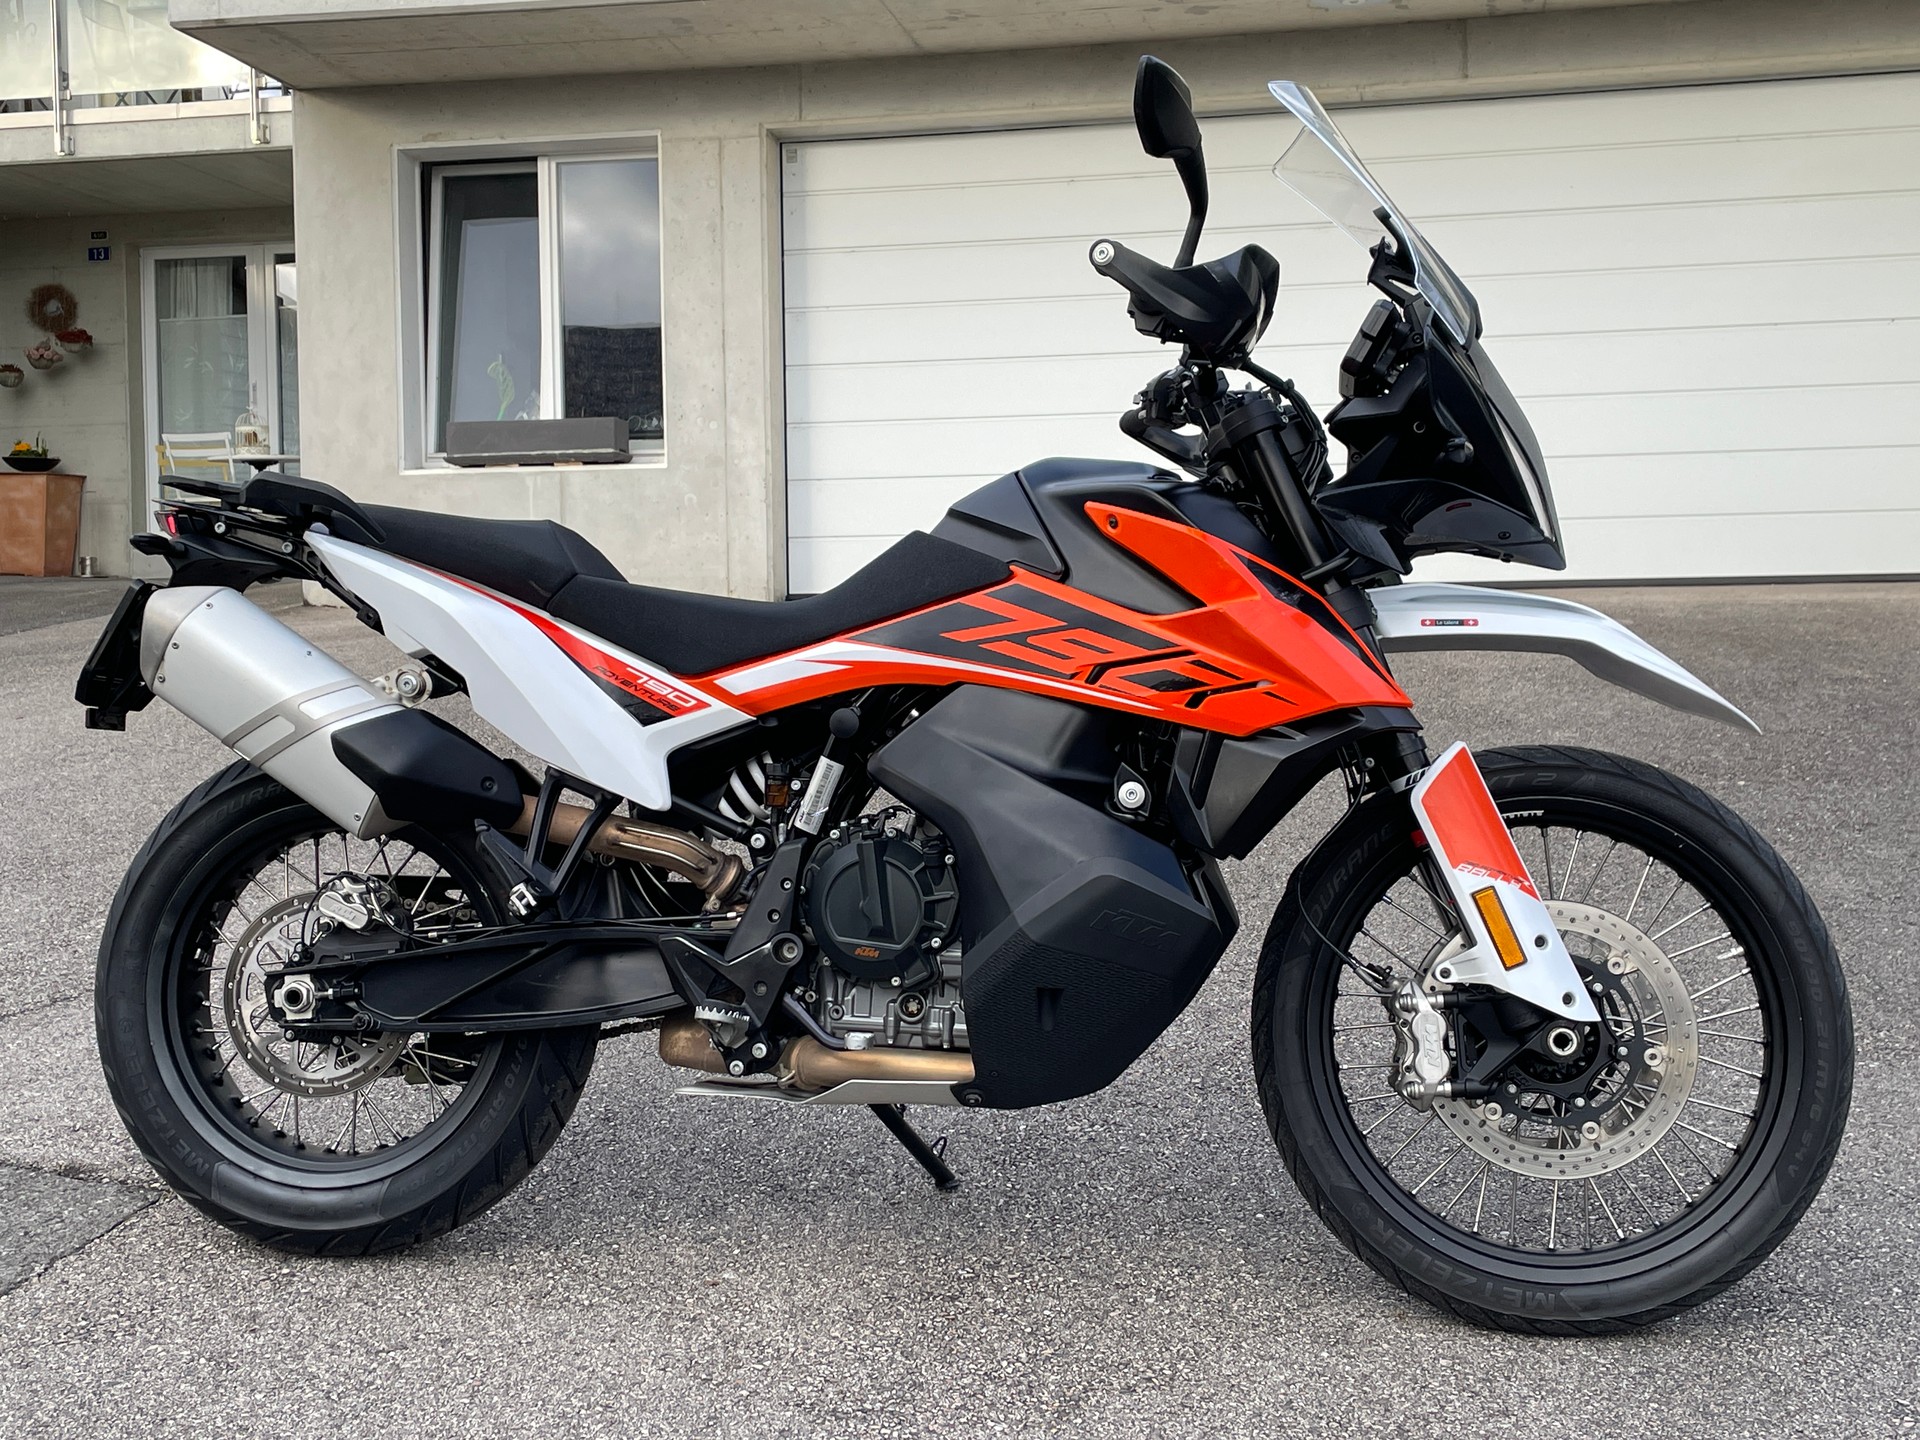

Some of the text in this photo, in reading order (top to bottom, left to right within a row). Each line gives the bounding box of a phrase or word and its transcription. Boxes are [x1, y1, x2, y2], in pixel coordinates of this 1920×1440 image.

[93, 248, 105, 260] 13
[593, 665, 681, 712] ADVENTURE
[626, 667, 698, 707] 790
[854, 946, 880, 959] KTM
[1090, 908, 1183, 954] KTM
[1366, 1216, 1556, 1312] METZELER
